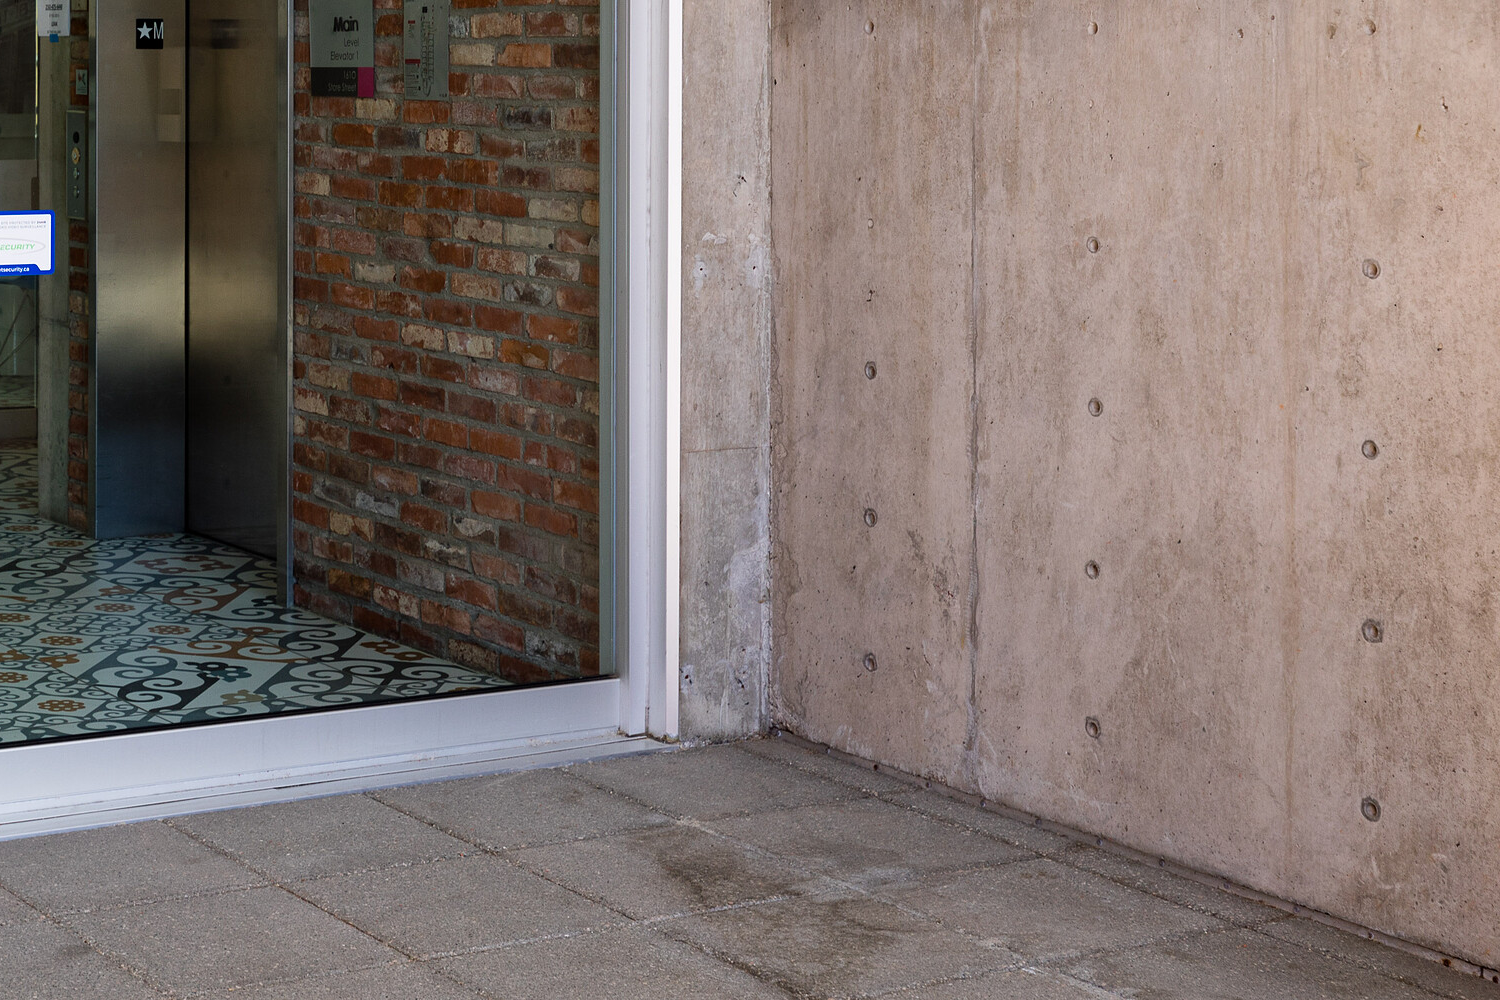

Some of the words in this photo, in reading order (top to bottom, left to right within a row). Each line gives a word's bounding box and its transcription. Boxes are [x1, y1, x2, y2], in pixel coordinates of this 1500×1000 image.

[153, 21, 164, 40] M
[333, 15, 359, 33] Main
[343, 37, 360, 48] Level
[330, 50, 355, 61] Elevator
